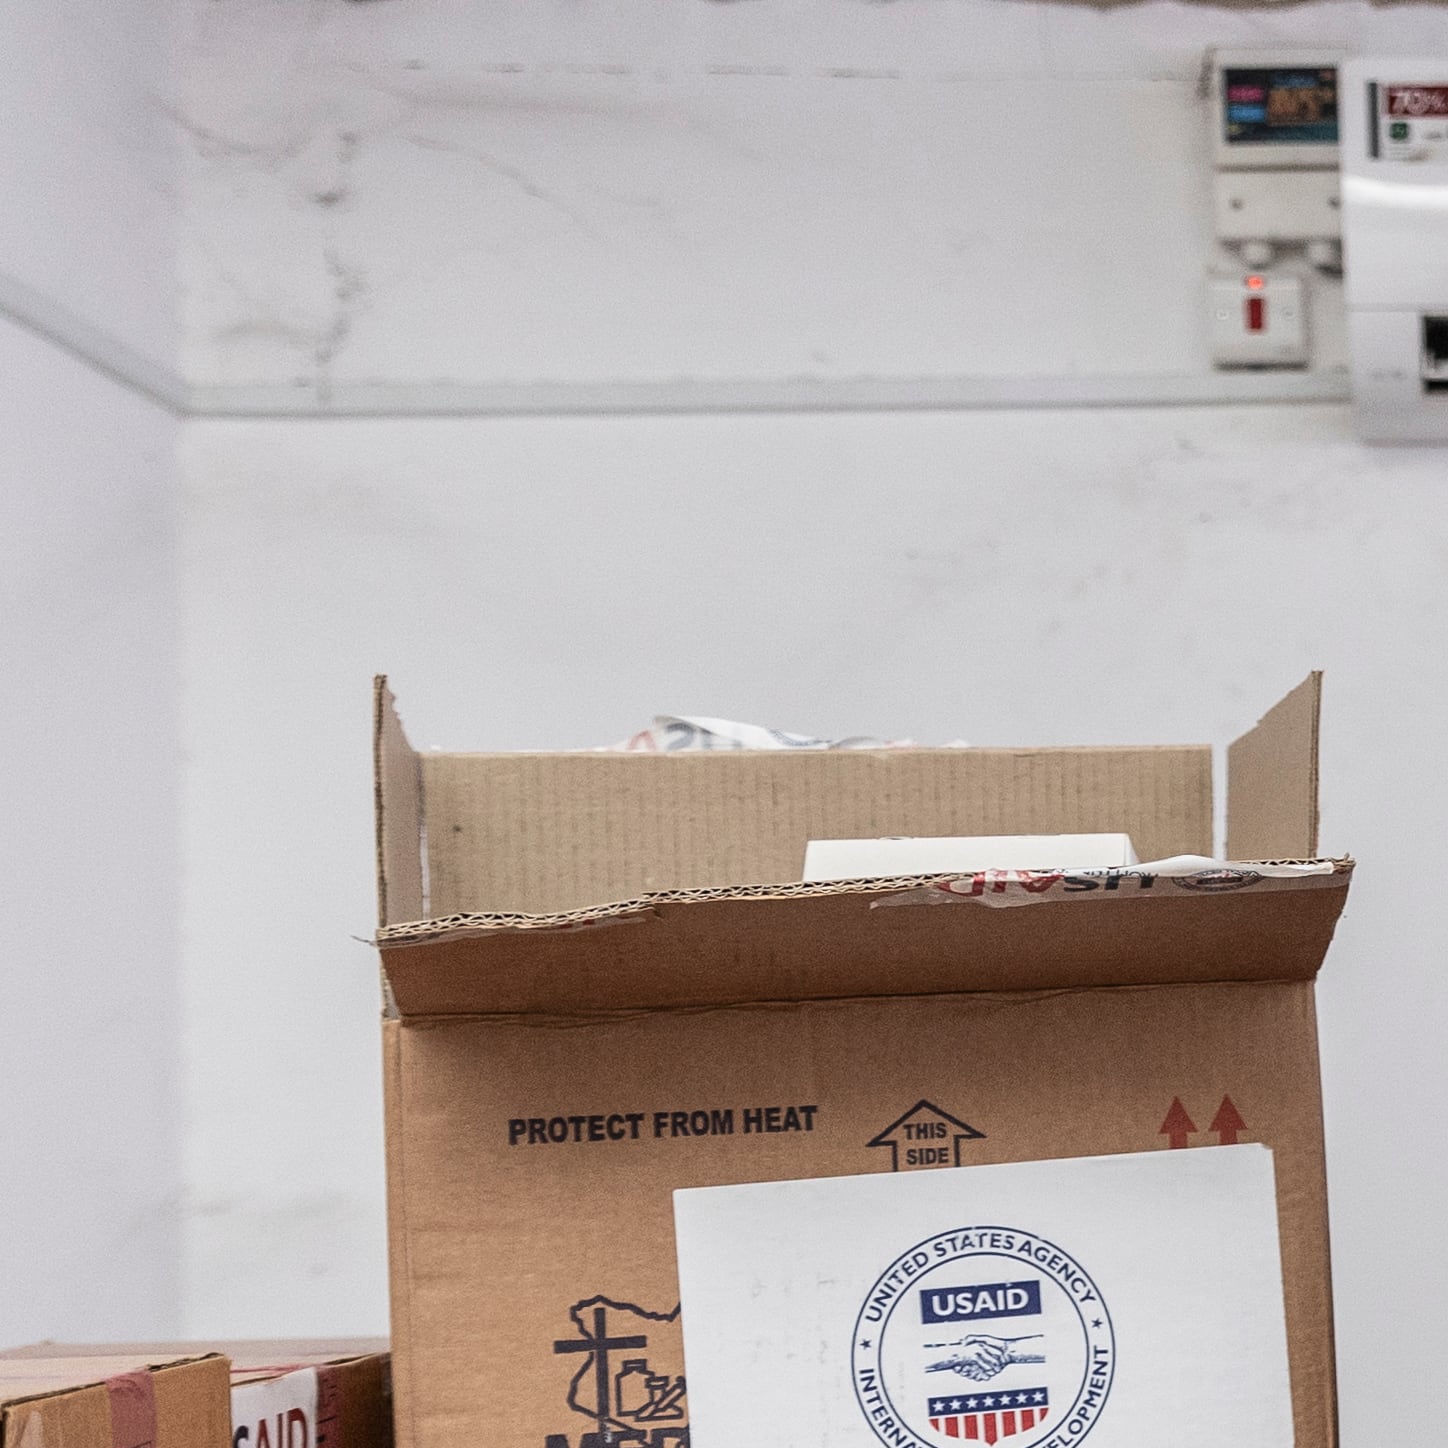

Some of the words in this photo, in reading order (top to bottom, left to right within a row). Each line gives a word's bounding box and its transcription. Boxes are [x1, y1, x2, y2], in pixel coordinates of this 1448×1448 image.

[508, 1113, 645, 1145] PROTECT
[653, 1109, 735, 1138] FROM
[743, 1105, 819, 1134] HEAT
[903, 1122, 948, 1141] THIS
[906, 1147, 950, 1166] SIDE
[865, 1251, 930, 1323] UNITED
[933, 1232, 1015, 1258] STATES
[1017, 1240, 1098, 1304] AGENCY
[931, 1288, 1030, 1317] USAID
